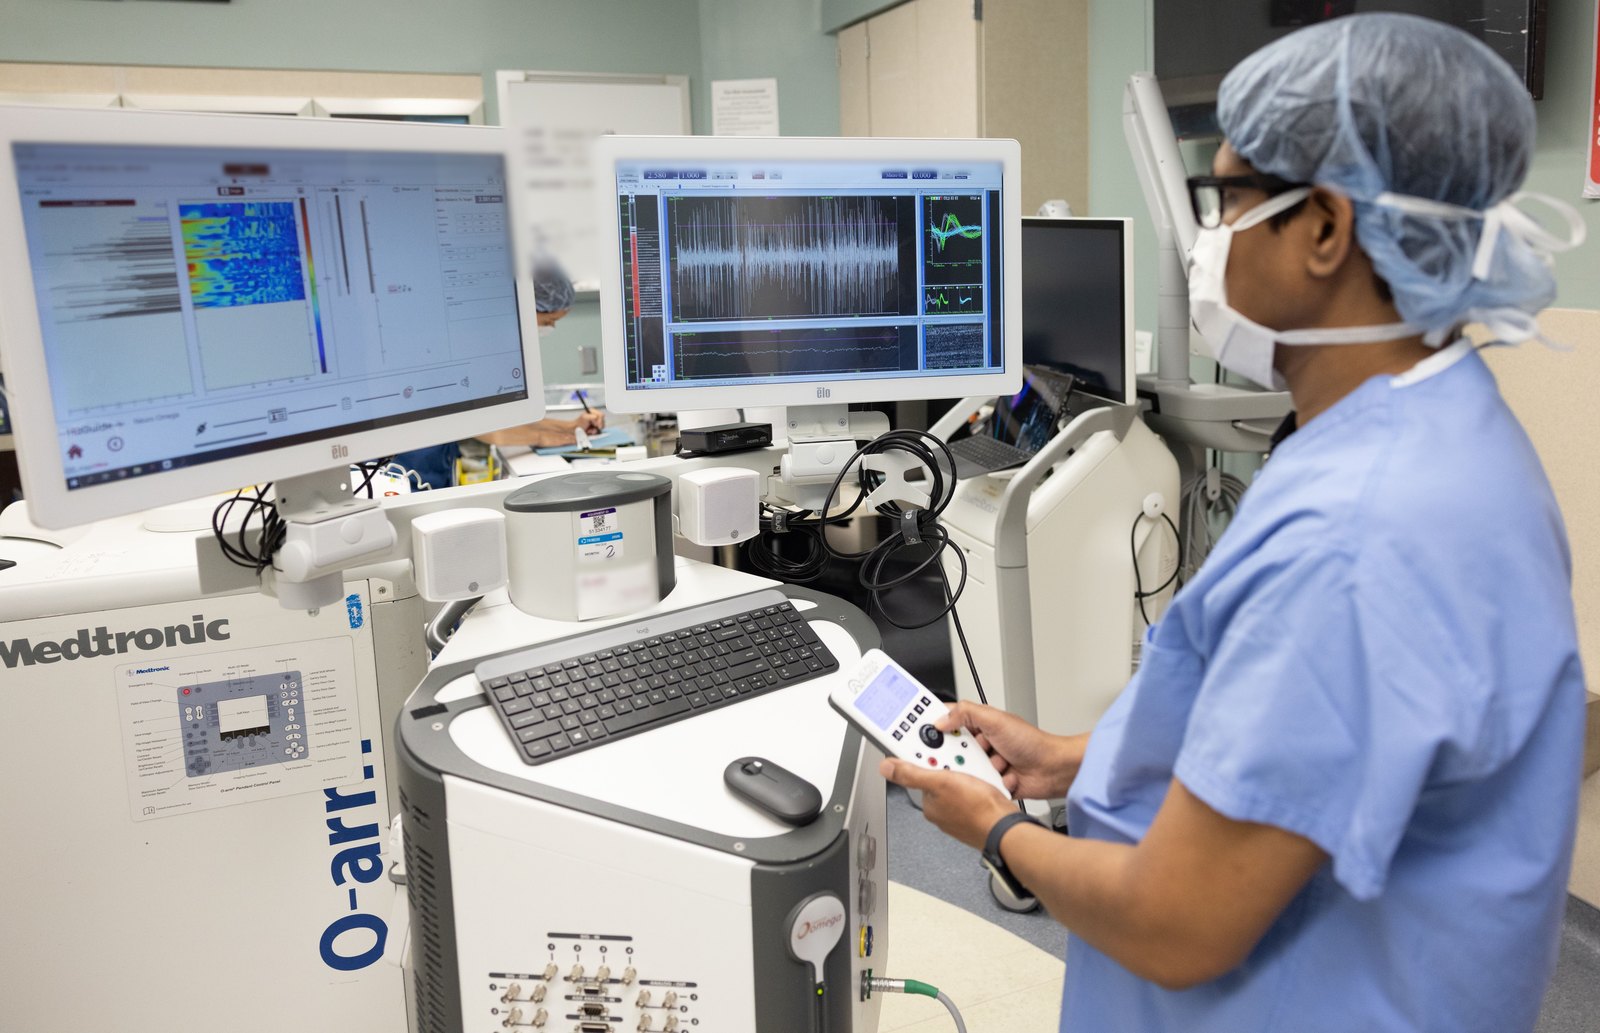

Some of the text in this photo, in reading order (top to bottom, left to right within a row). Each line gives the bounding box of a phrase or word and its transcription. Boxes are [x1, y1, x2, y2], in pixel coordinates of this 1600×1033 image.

[606, 544, 616, 558] 2
[0, 614, 230, 668] Medtronic
[136, 666, 170, 674] Medtronic
